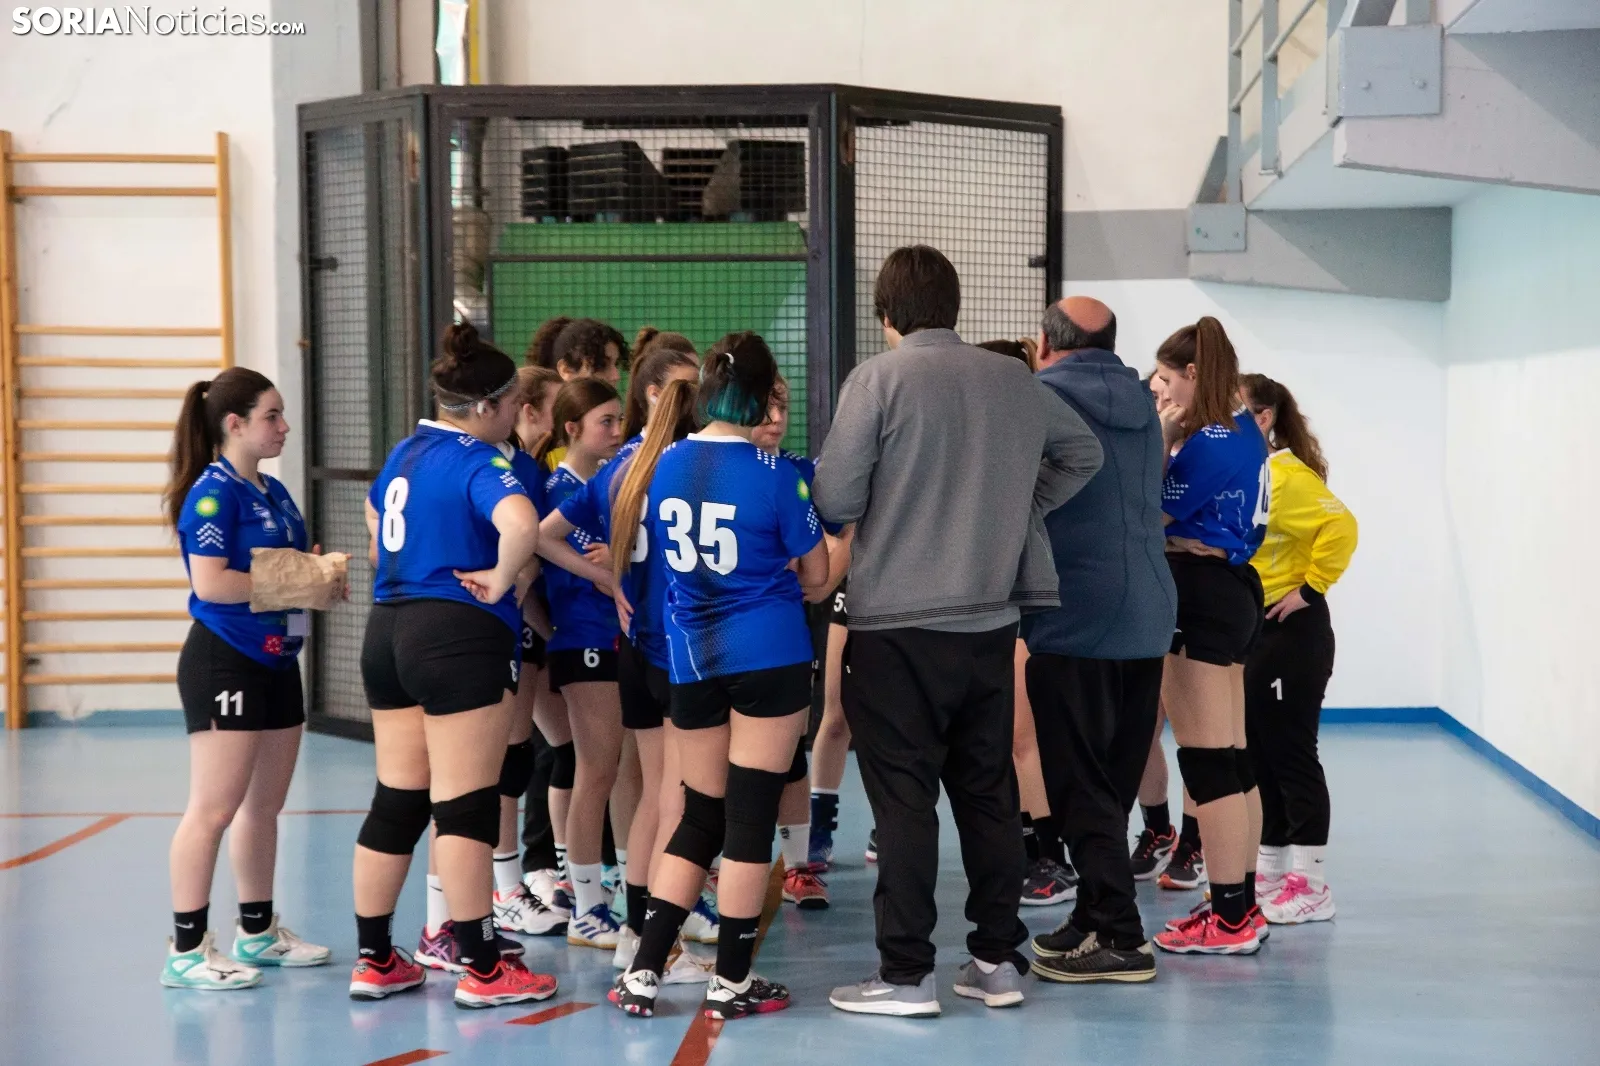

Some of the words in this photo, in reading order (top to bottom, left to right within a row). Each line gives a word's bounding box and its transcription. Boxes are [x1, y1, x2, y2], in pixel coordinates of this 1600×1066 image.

[382, 476, 409, 553] 8
[659, 497, 738, 576] 35
[833, 592, 848, 614] 5
[583, 647, 600, 668] 6
[1270, 677, 1283, 701] 1
[214, 690, 244, 716] 11
